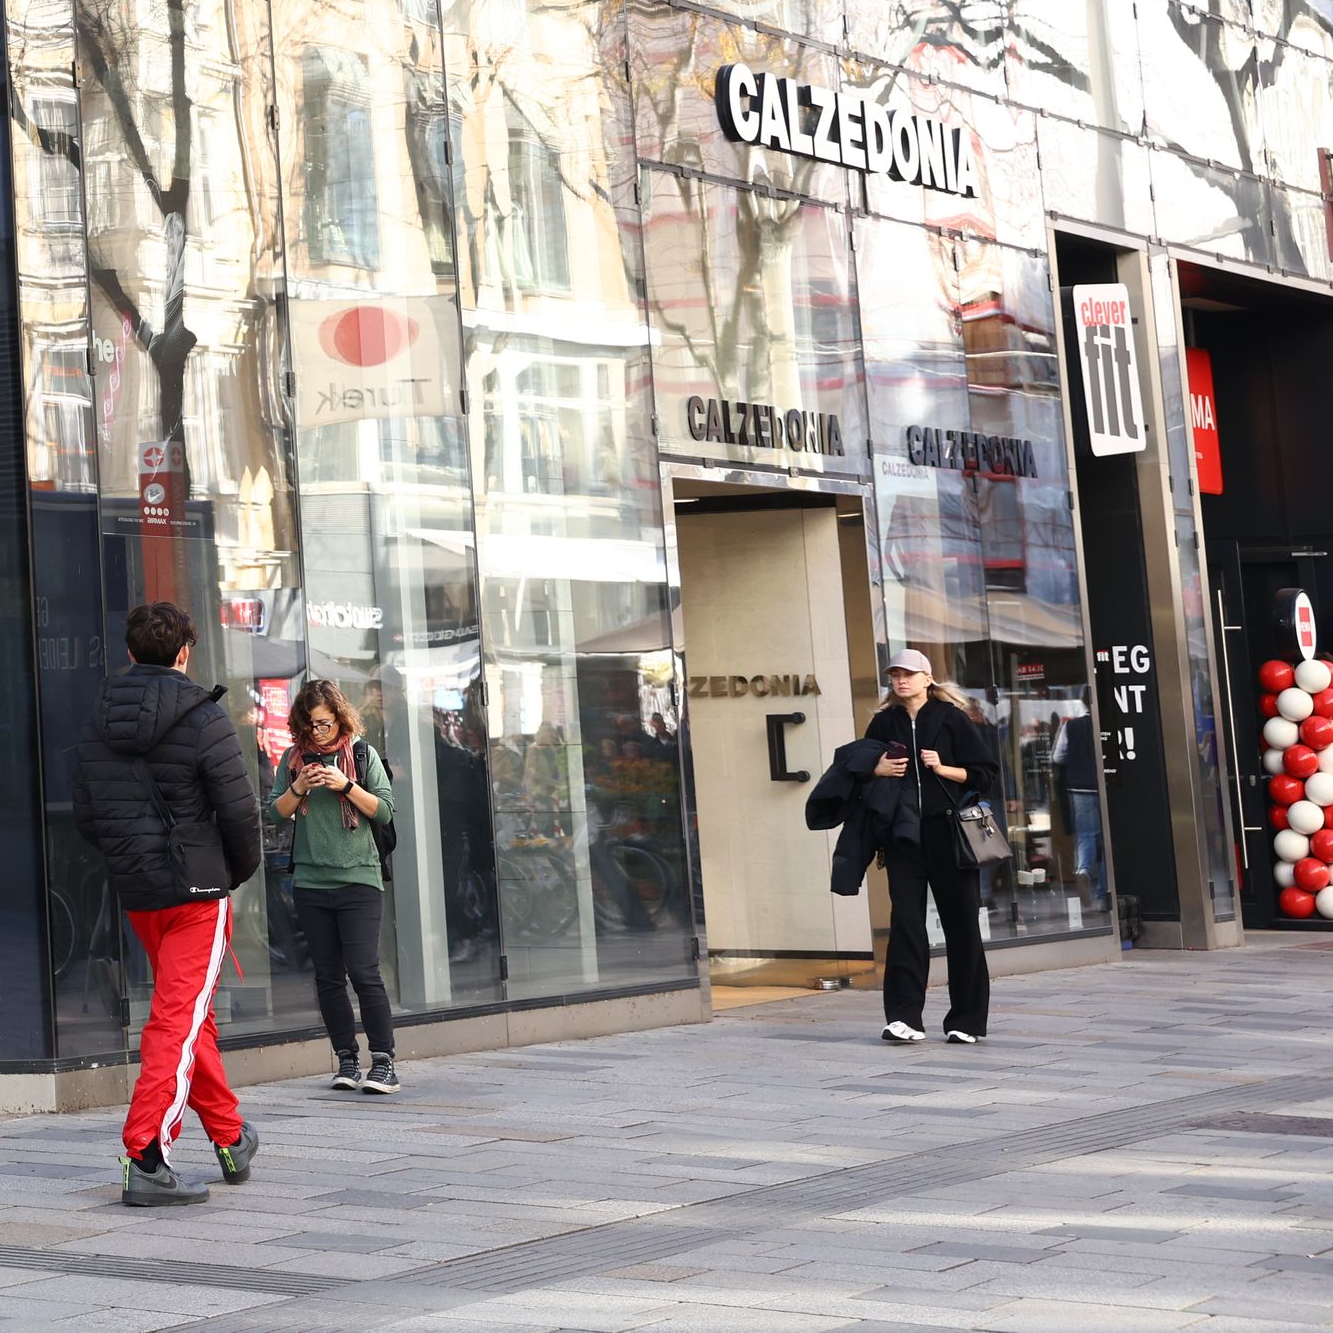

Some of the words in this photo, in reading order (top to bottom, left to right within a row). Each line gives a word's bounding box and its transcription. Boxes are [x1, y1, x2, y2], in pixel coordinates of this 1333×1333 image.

[719, 63, 981, 199] CALZEDONIA
[1081, 297, 1126, 327] clever
[1084, 322, 1139, 439] fit
[687, 395, 845, 457] CALZEDONIA
[882, 461, 930, 480] CALZEDONIA
[906, 424, 1038, 478] CALZEDONIA
[1112, 644, 1151, 674] EG
[689, 674, 822, 698] ZEDONIA
